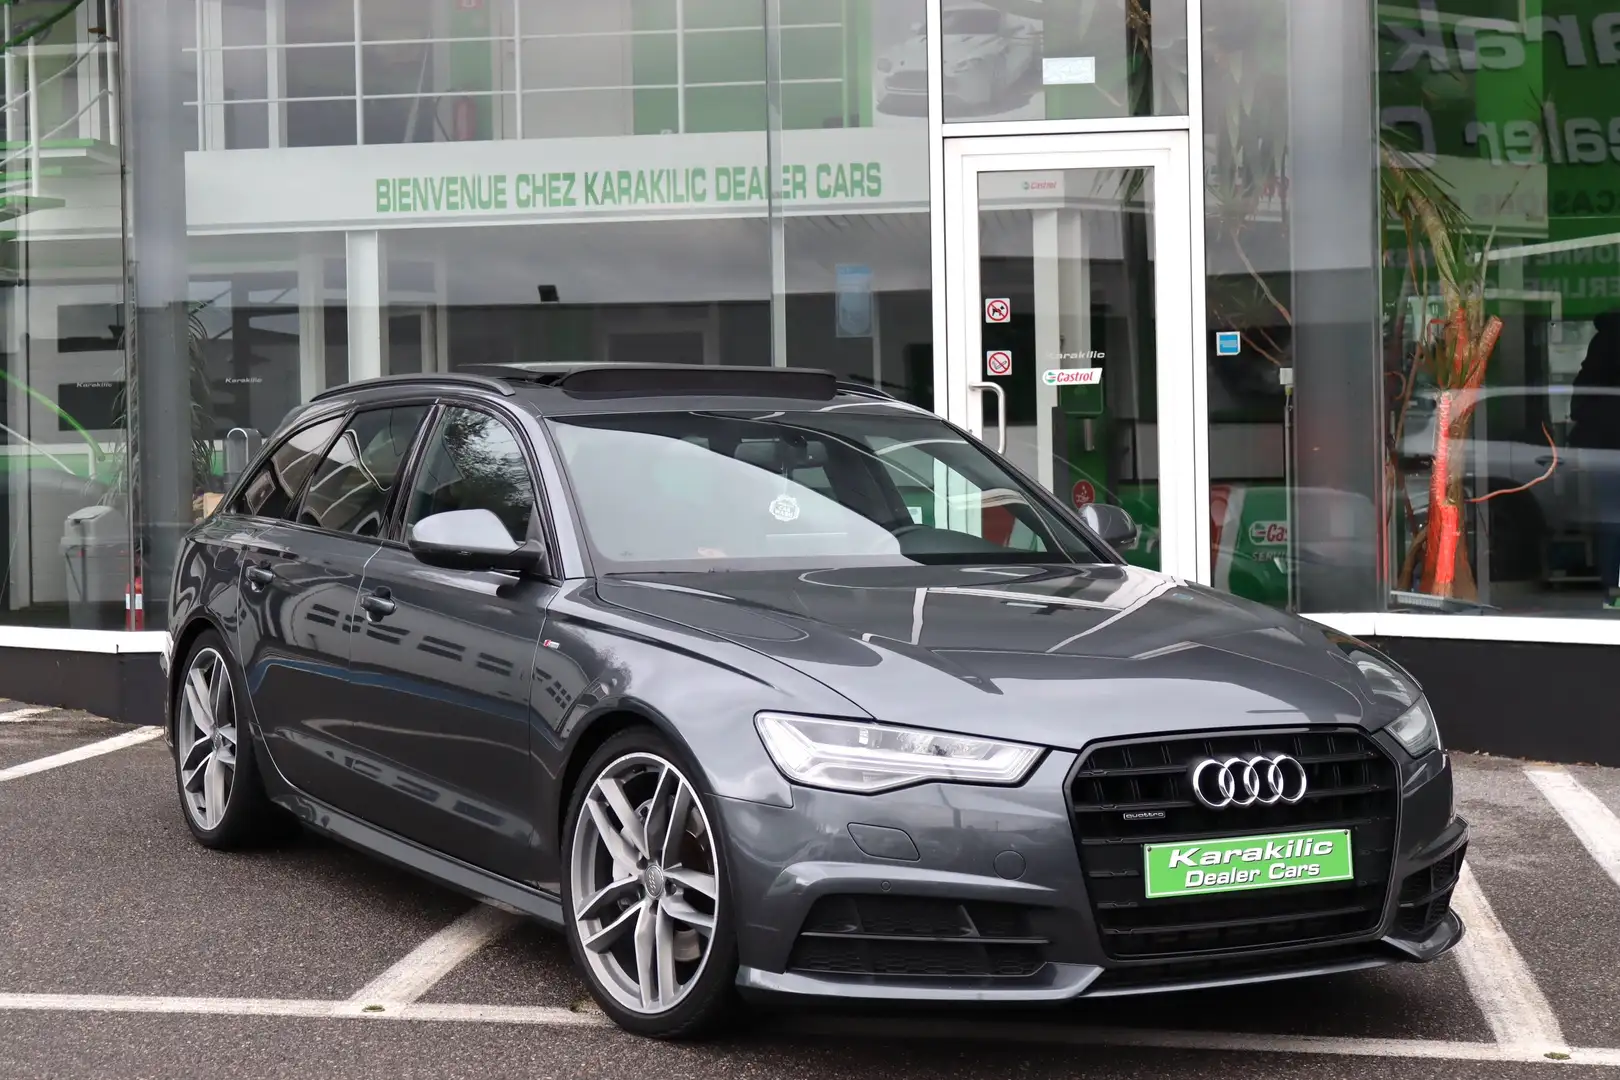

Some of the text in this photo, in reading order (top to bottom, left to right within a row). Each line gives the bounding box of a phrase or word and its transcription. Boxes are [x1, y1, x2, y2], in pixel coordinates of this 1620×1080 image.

[376, 174, 507, 213] BIENVENUE
[515, 172, 576, 208] CHEZ
[584, 167, 707, 206] KARAKILIC
[816, 162, 882, 199] CARS
[1056, 371, 1094, 383] Castrol
[1168, 838, 1334, 869] Karakilic
[1184, 861, 1321, 888] Dealer Cars
